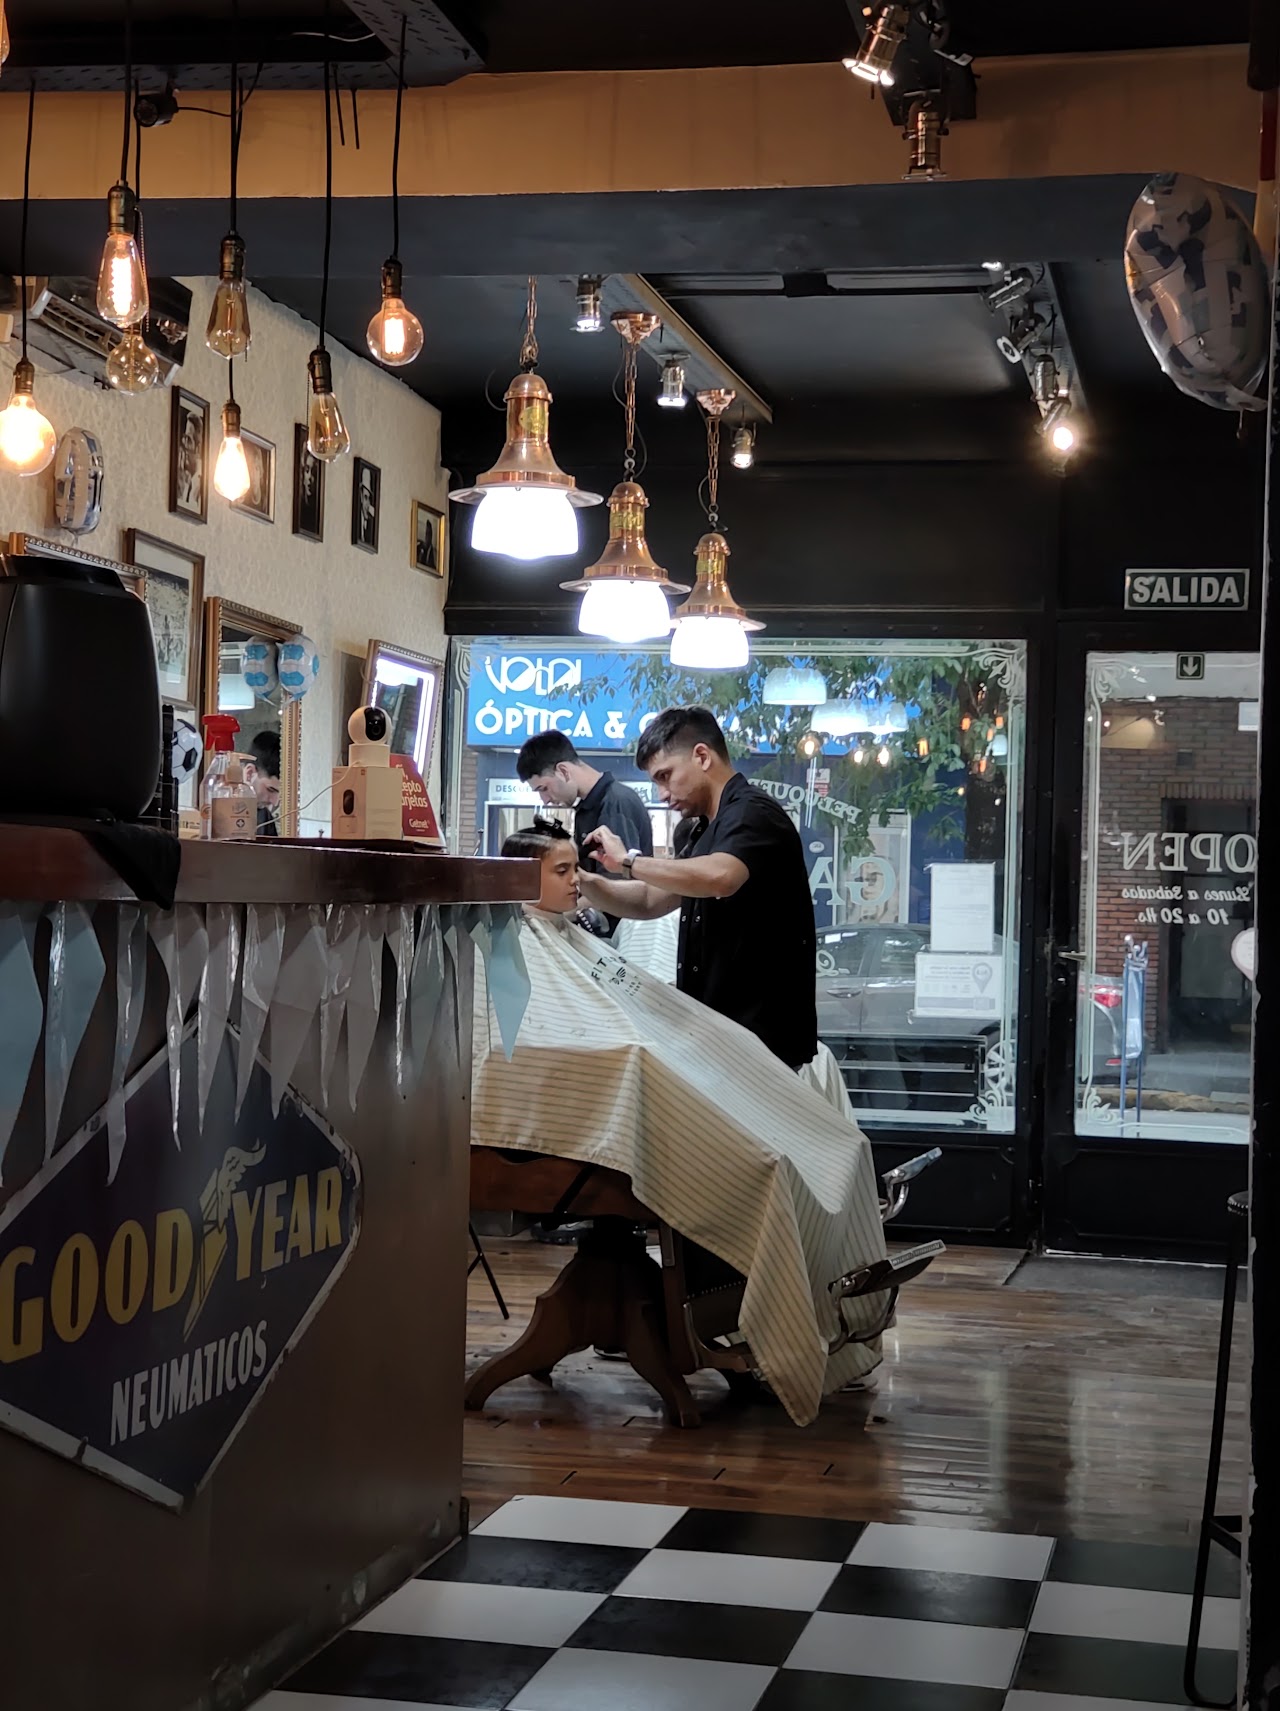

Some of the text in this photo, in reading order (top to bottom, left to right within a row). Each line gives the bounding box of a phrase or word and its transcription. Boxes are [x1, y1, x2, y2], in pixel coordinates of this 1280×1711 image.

[1132, 576, 1240, 603] SALIDA
[475, 699, 593, 738] ÓPTICA
[603, 711, 628, 739] &
[110, 1320, 268, 1446] NEUMATICOS
